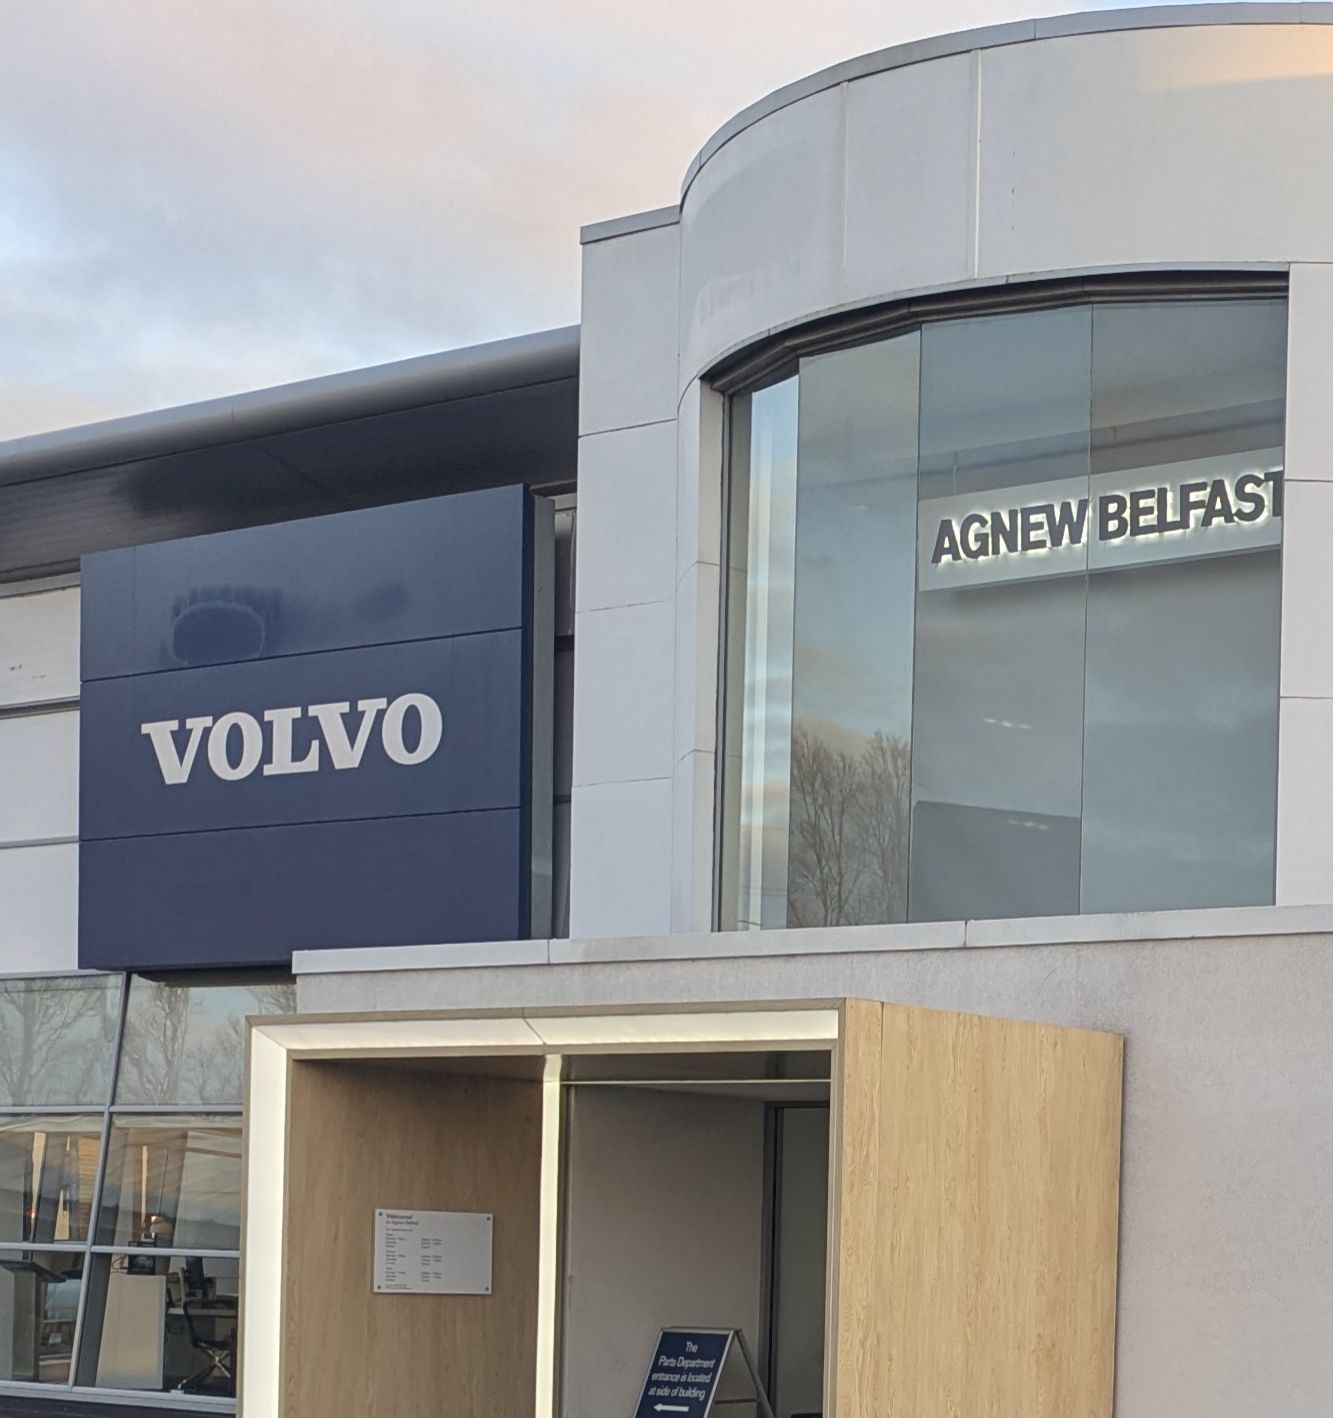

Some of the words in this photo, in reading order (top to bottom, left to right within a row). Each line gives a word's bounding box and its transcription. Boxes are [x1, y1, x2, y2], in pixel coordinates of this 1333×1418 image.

[931, 498, 1089, 565] AGNEW
[1098, 466, 1283, 542] BELFAST
[141, 692, 443, 785] VOLVO
[686, 1341, 698, 1353] The
[658, 1355, 676, 1367] Parts
[677, 1356, 716, 1370] Department
[652, 1372, 680, 1382] entrance
[680, 1371, 687, 1382] is
[687, 1372, 712, 1383] located
[648, 1386, 656, 1395] at
[656, 1386, 671, 1396] side
[671, 1386, 679, 1396] of
[678, 1386, 706, 1401] building
